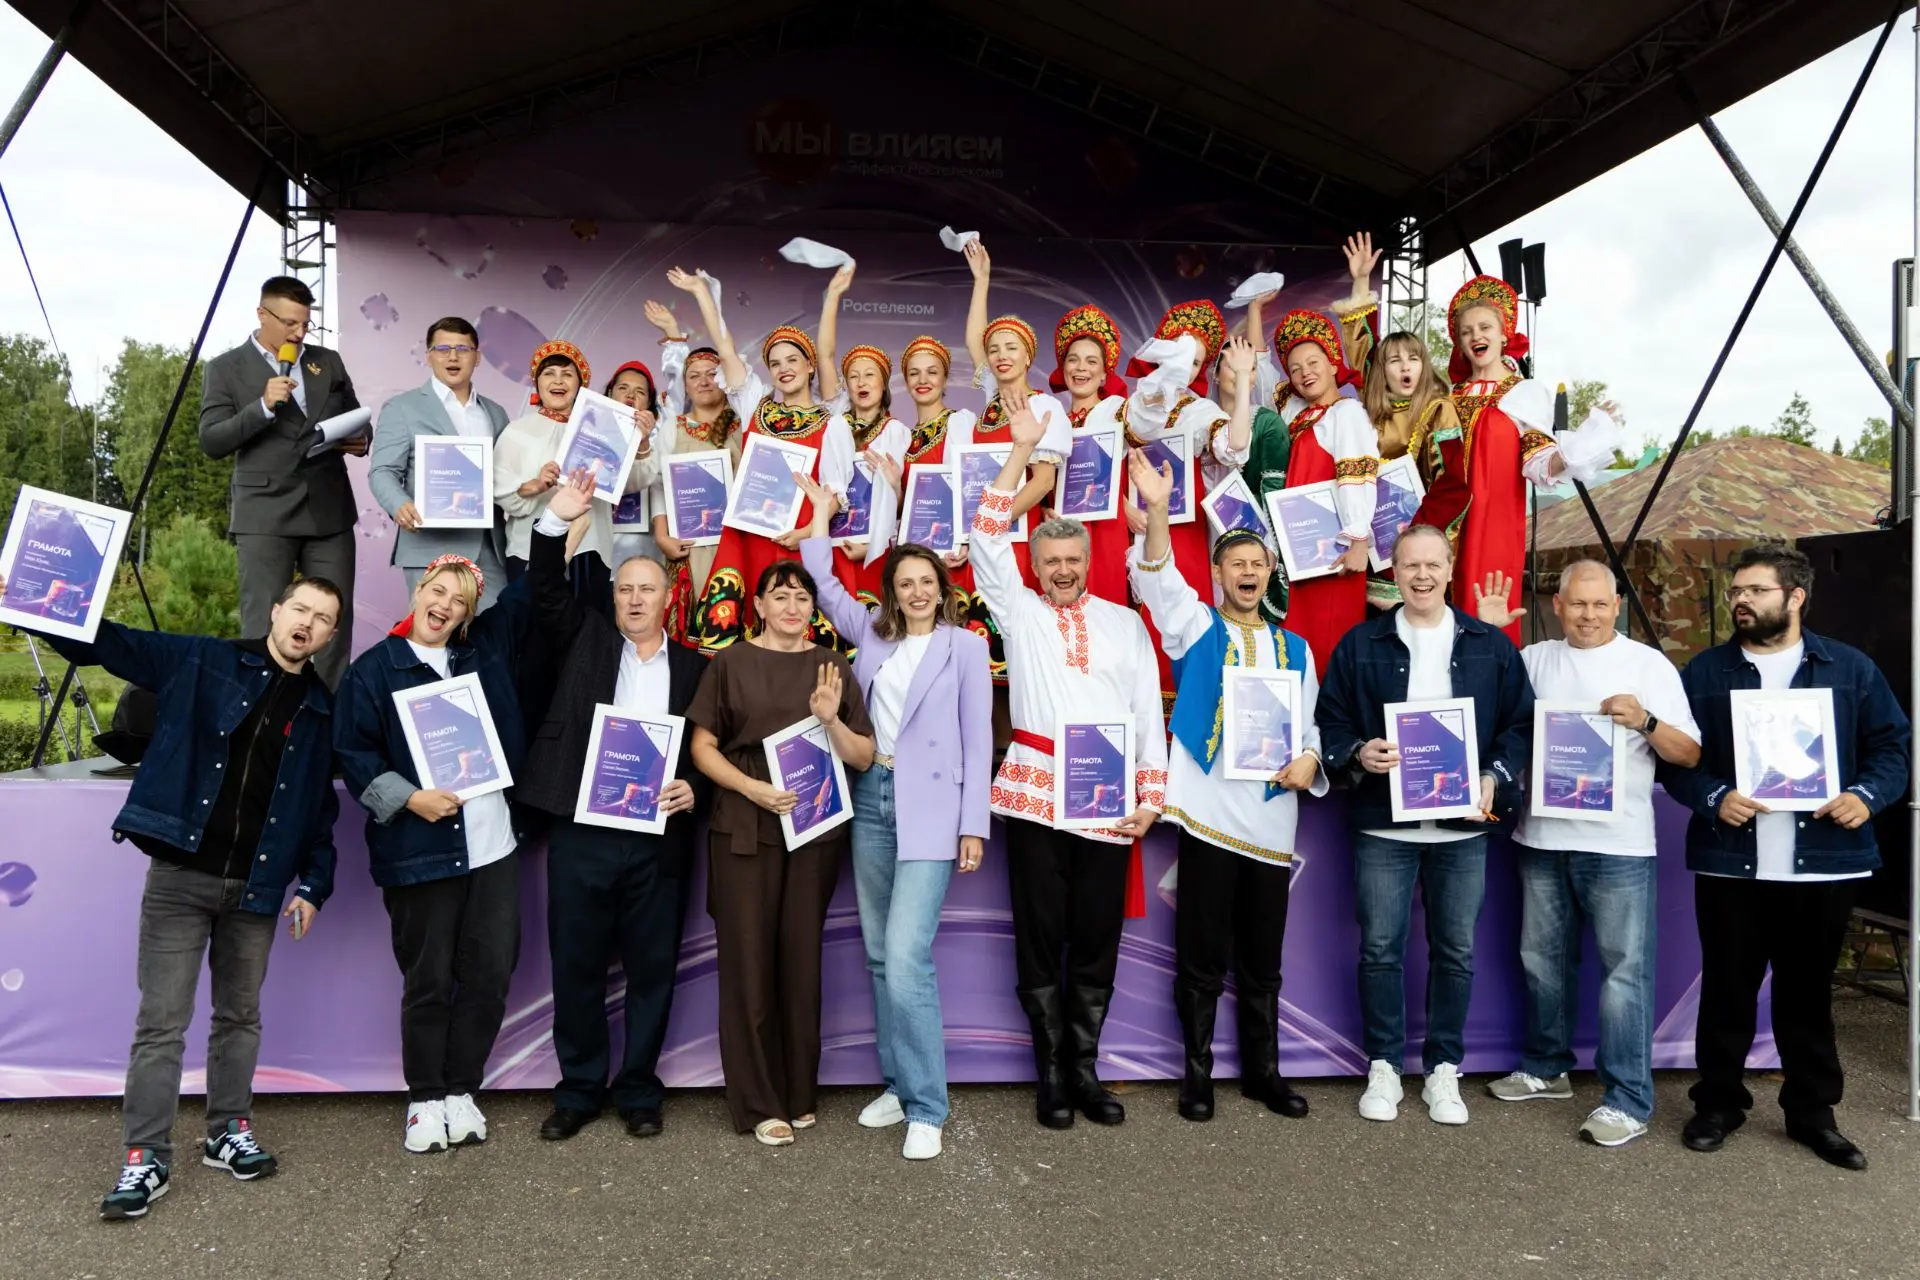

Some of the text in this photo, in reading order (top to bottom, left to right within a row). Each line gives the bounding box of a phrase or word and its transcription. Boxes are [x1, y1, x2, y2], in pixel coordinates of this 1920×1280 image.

[848, 131, 1003, 161] влияем
[842, 299, 935, 315] Ростелеком
[1069, 461, 1095, 470] ГРАМОТА
[750, 471, 779, 483] ГРАМОТА
[677, 487, 706, 495] ГРАМОТА
[1288, 518, 1319, 529] ГРАМОТА
[28, 539, 72, 558] ГРАМОТА
[424, 725, 458, 741] ГРАМОТА
[1404, 744, 1441, 754] ГРАМОТА
[1550, 745, 1587, 753] ГРАМОТА
[604, 750, 641, 762] ГРАМОТА
[786, 764, 815, 782] ГРАМОТА
